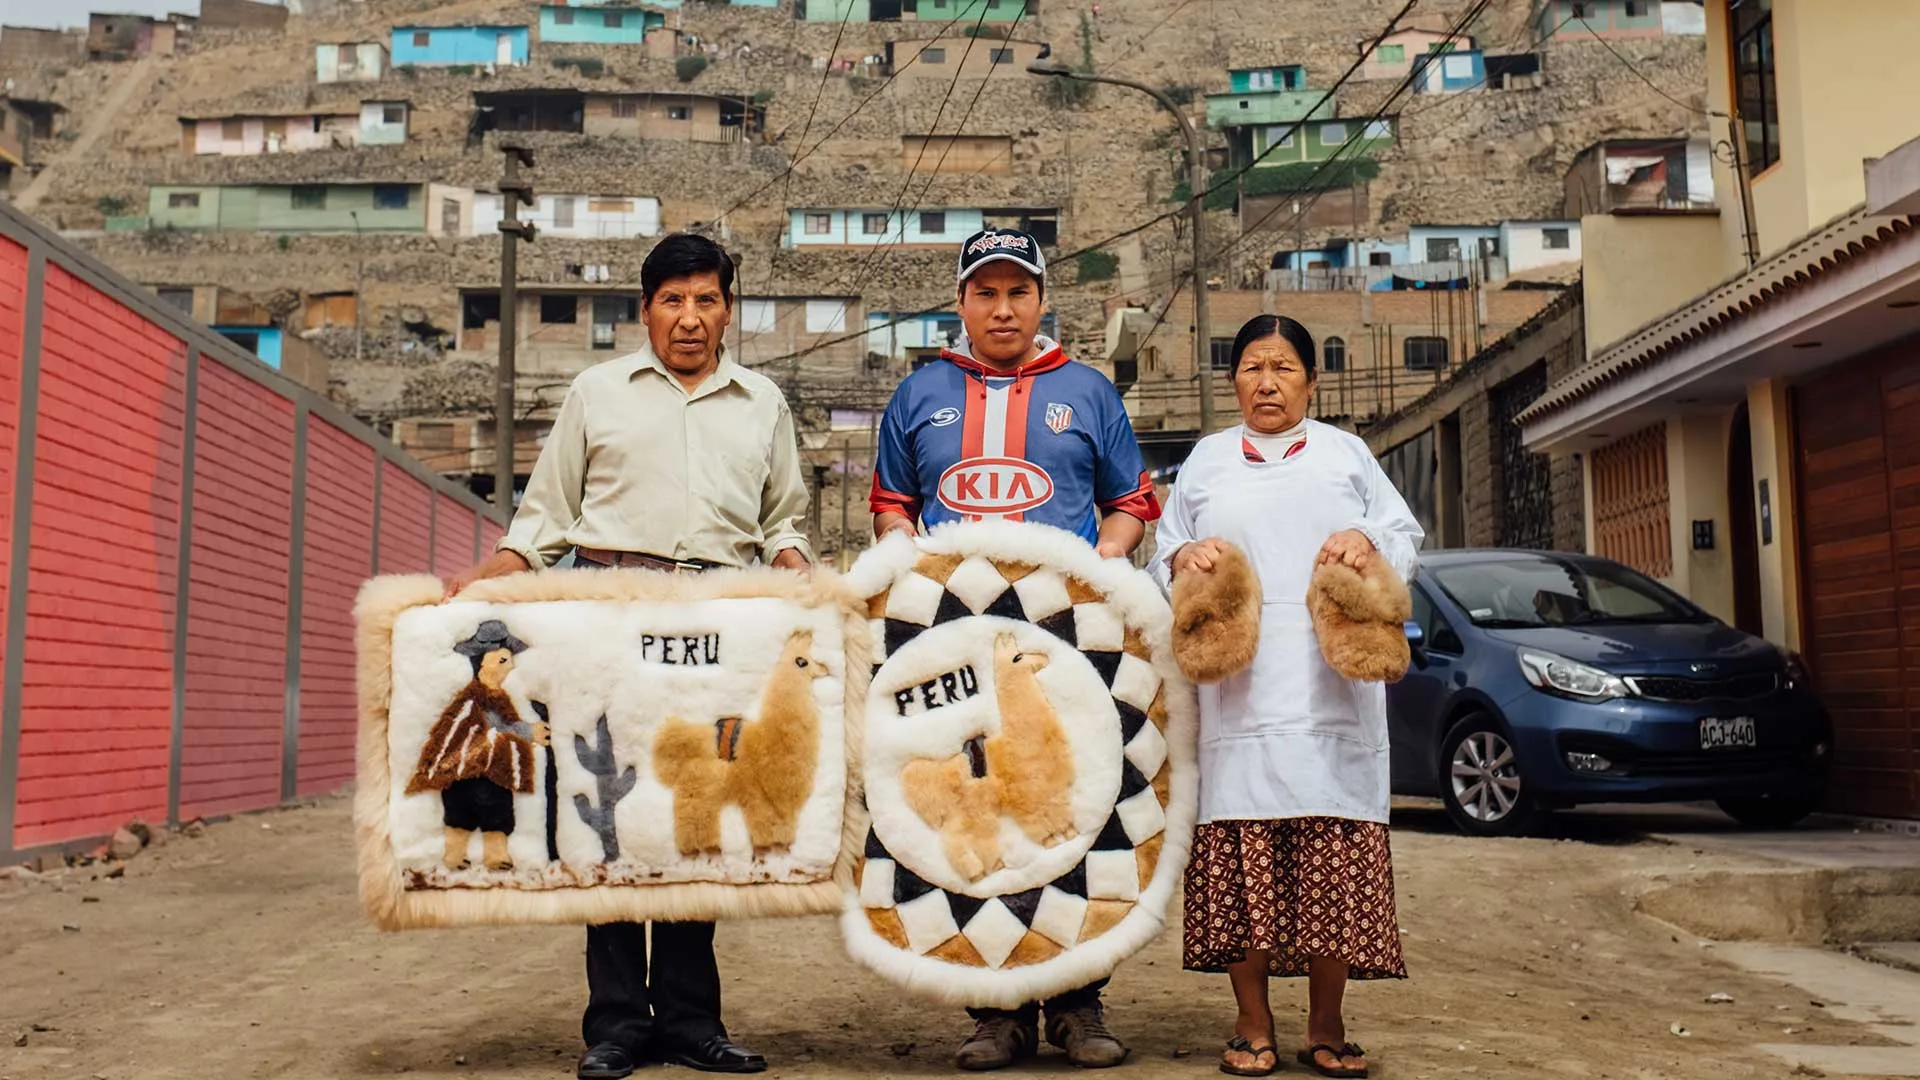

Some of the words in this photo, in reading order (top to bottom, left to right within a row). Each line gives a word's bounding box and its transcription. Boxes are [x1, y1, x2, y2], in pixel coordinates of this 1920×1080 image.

[956, 472, 1034, 500] KIA
[641, 632, 719, 665] PERU
[894, 664, 979, 716] PERU
[1702, 724, 1754, 745] ACJ-640
